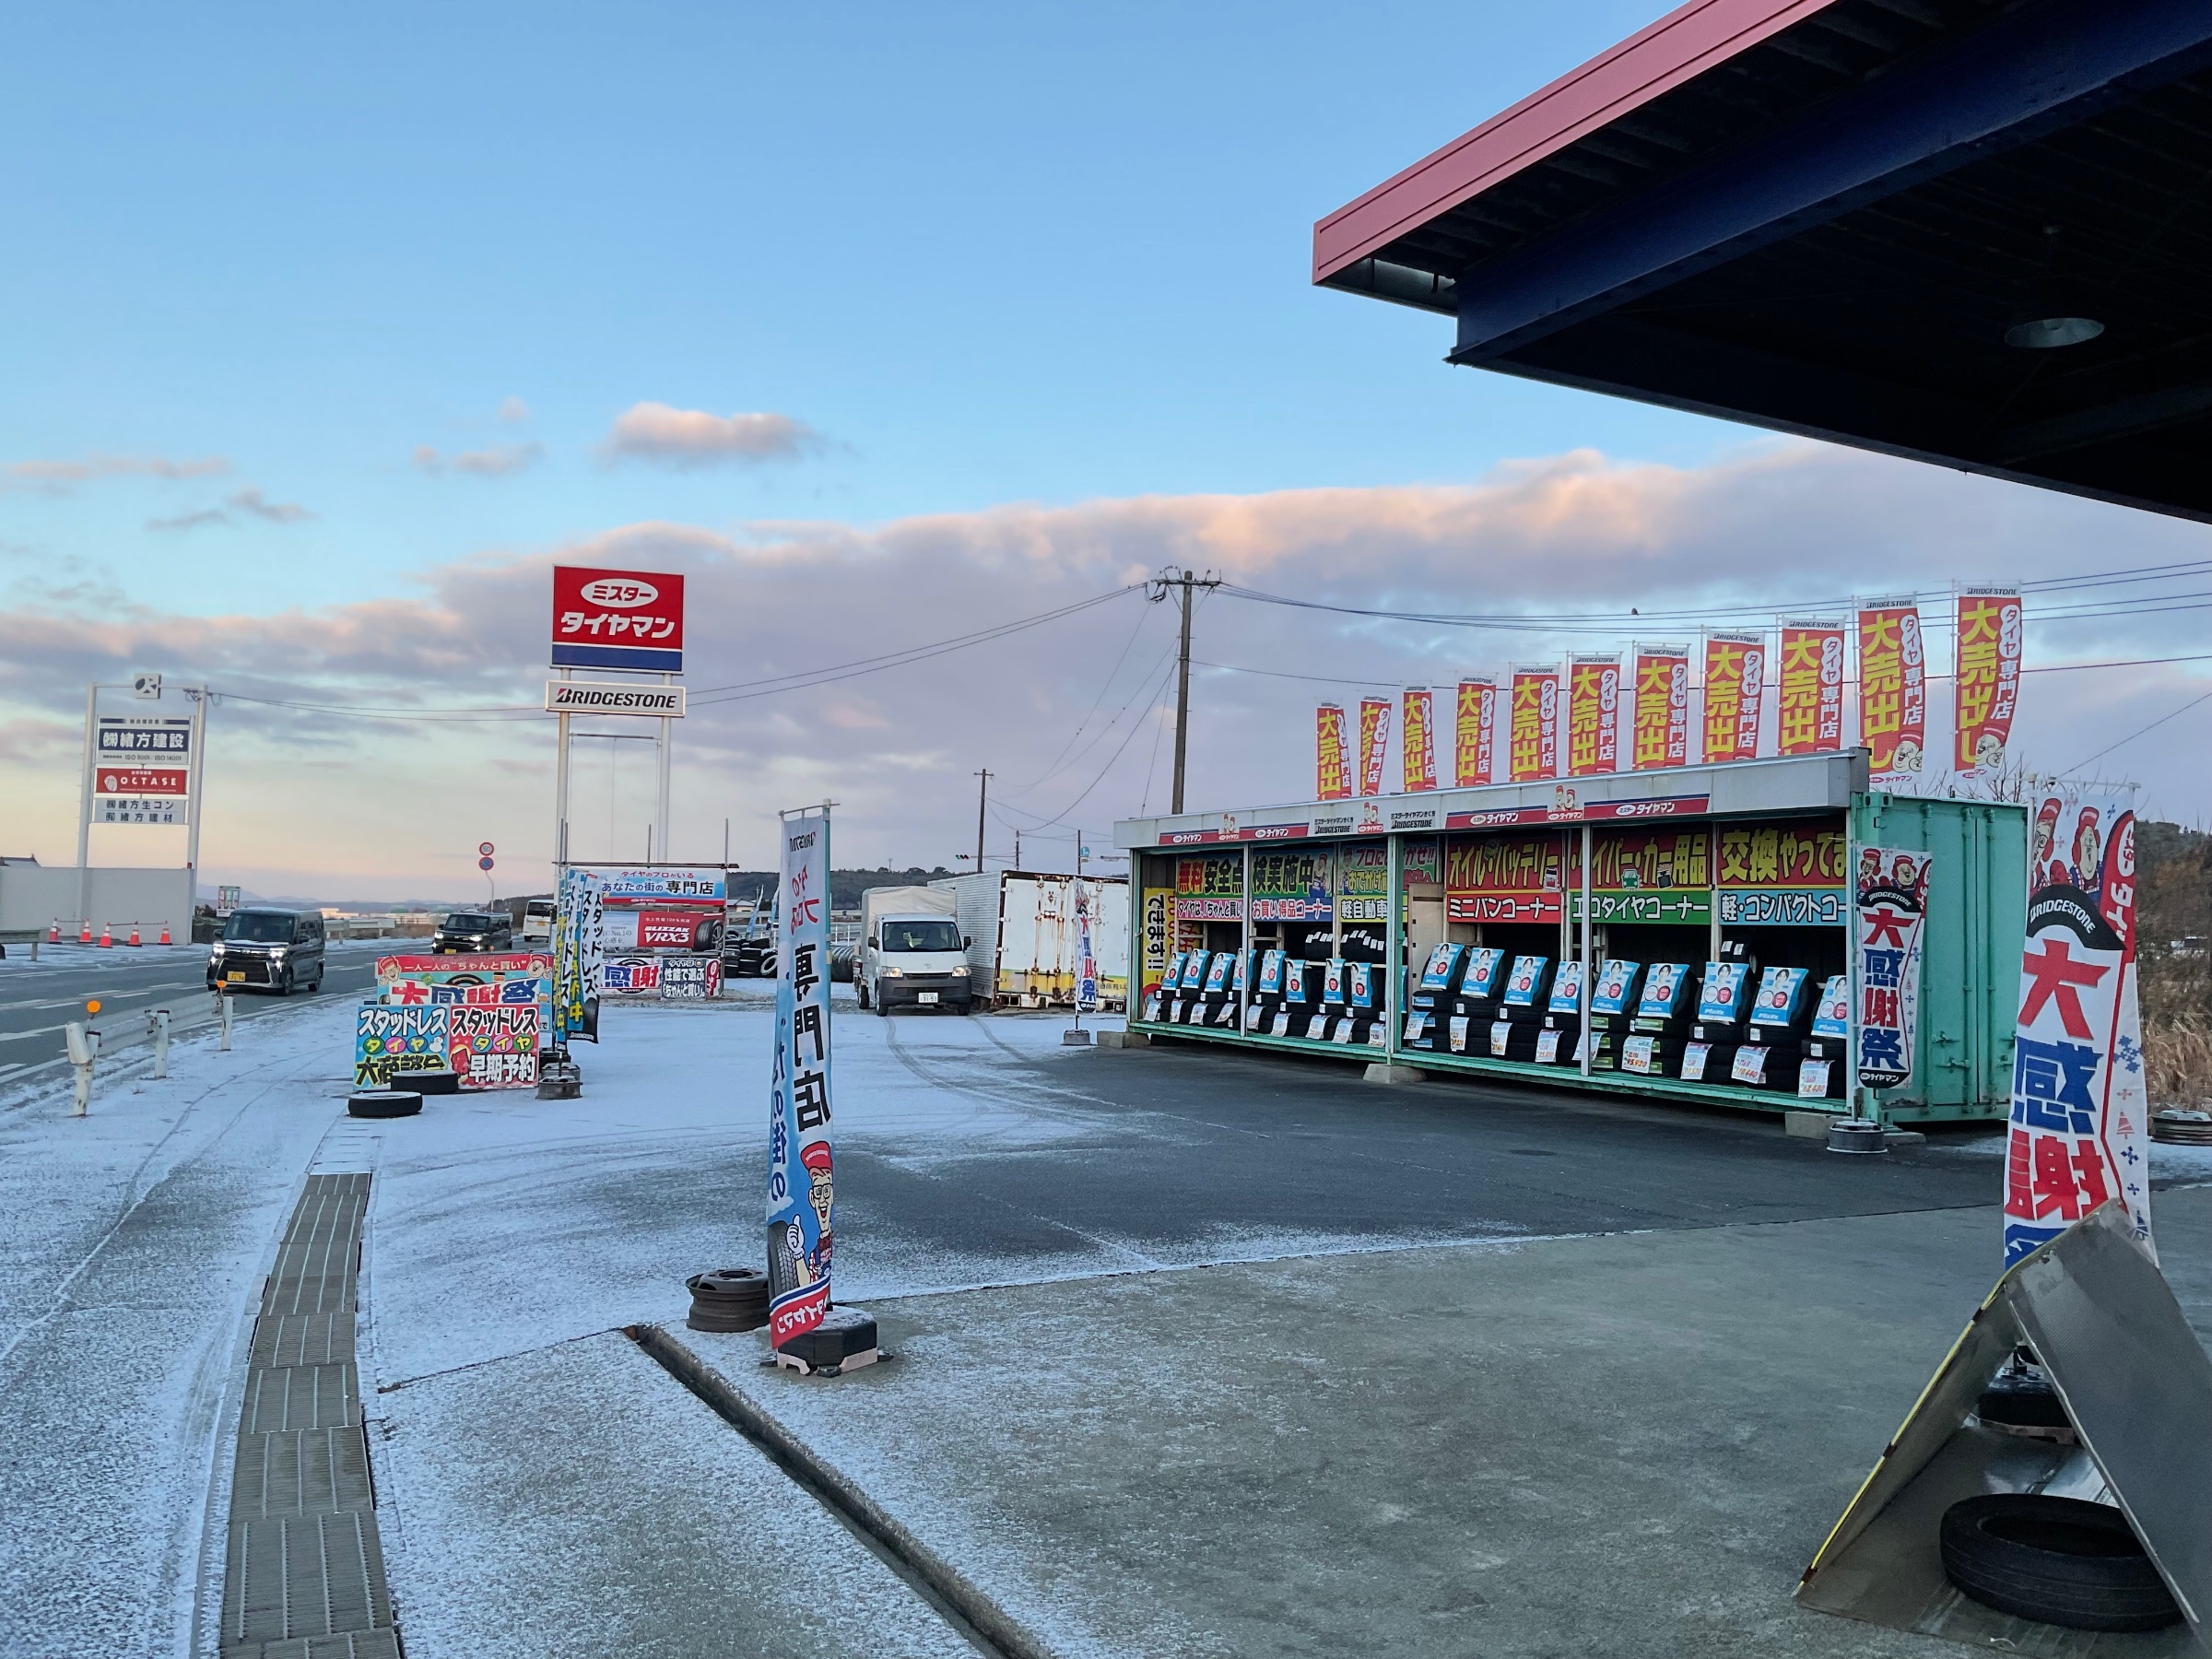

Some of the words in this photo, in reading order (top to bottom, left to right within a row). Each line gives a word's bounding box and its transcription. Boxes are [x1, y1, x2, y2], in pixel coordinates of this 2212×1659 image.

[593, 584, 651, 601] ミスター
[1967, 587, 2017, 595] BRIDGESTONE
[1865, 599, 1912, 609] BRIDGESTONE
[560, 611, 675, 639] タイヤマン
[1789, 620, 1839, 629] BRIDGESTONE
[1713, 632, 1759, 643] BRIDGESTONE
[1643, 648, 1685, 657] BRIDGESTONE
[555, 688, 677, 708] BRIDGESTONE
[1782, 632, 1821, 755] 大売出
[1862, 613, 1900, 769] 大売出し
[1706, 645, 1743, 762] 大売出
[1571, 665, 1601, 776] 大売出
[1636, 659, 1671, 769] 大売出
[1457, 686, 1480, 786] 大売出
[1512, 677, 1540, 782] 大売出
[1405, 694, 1424, 792] 大売出
[1318, 710, 1340, 799] 大売出
[120, 777, 177, 786] OCTASE
[1487, 812, 1519, 823] タイヤマン
[1636, 802, 1675, 815] タイヤマン
[1266, 828, 1288, 838] タイヤマン
[1391, 819, 1432, 830] BRIDGESTONE
[1182, 833, 1202, 842] タイヤマン
[1868, 890, 1912, 907] BRIDGESTONE
[1253, 899, 1332, 920] お買い得品コーナー
[1448, 896, 1559, 920] ミニバンコーナー
[2030, 899, 2097, 935] BRIDGESTONE
[644, 932, 689, 944] VRX3
[665, 968, 704, 982] 性能で選ぶ
[1859, 908, 1916, 1069] 大感謝祭
[358, 1006, 448, 1037] スタッドレス
[451, 1006, 538, 1037] スタッドレス
[365, 1038, 426, 1053] タイヤ
[474, 1036, 533, 1053] タイヤ
[469, 1053, 536, 1084] 早期予約
[1870, 1073, 1899, 1082] タイヤマン
